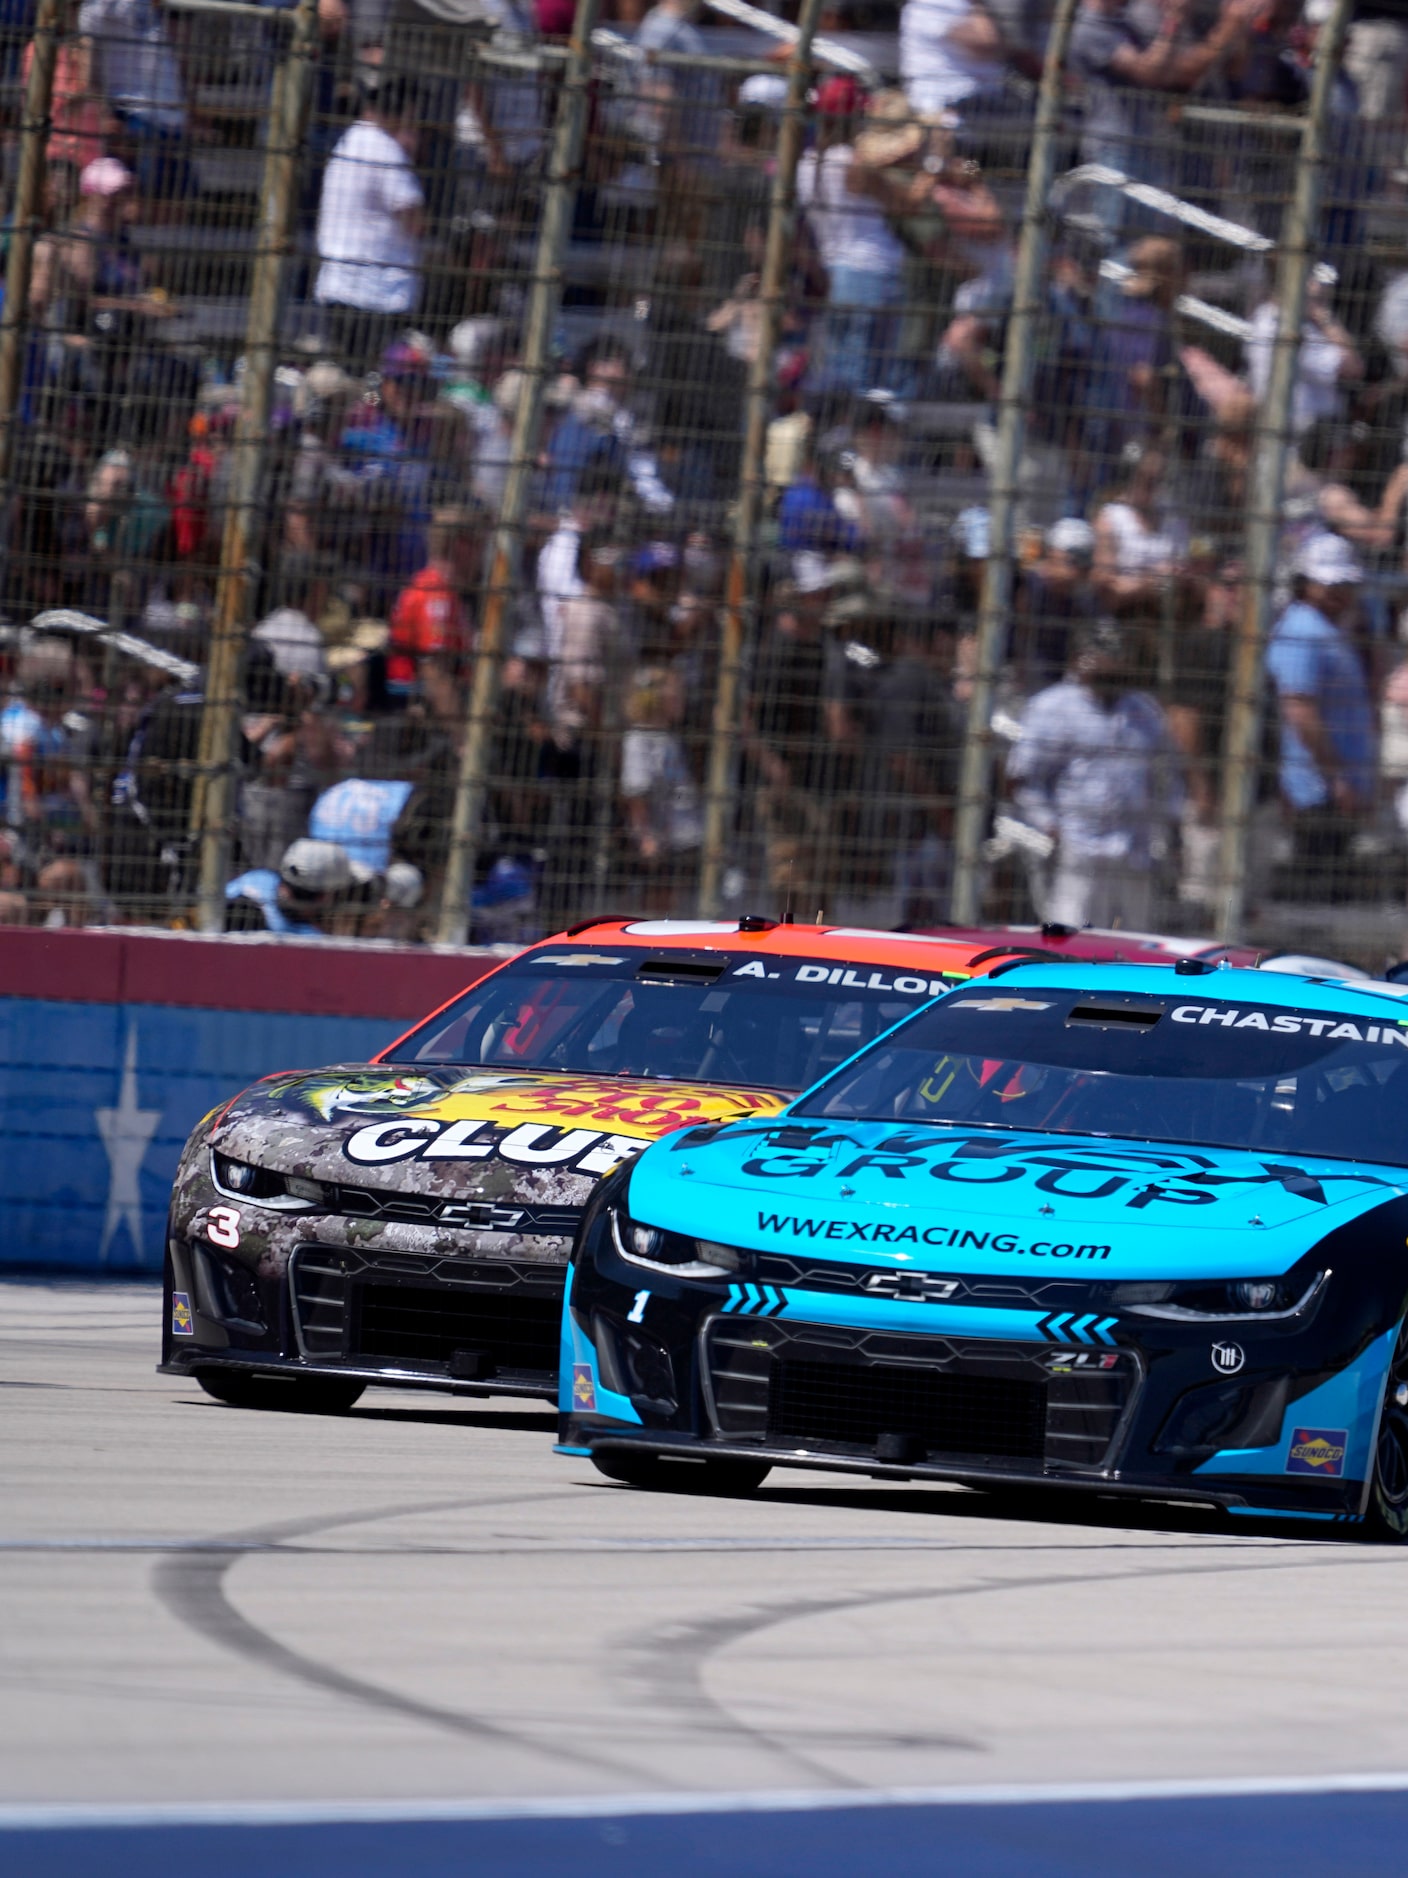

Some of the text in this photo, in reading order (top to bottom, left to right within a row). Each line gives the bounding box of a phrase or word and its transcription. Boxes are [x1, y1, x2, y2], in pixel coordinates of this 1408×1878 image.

[733, 961, 955, 997] A. DILLON
[740, 1152, 1221, 1210] GROUP
[207, 1206, 241, 1249] 3
[757, 1210, 1112, 1260] WWEXRACING.com
[627, 1289, 652, 1323] 1
[1292, 1444, 1343, 1461] SUNOCO
